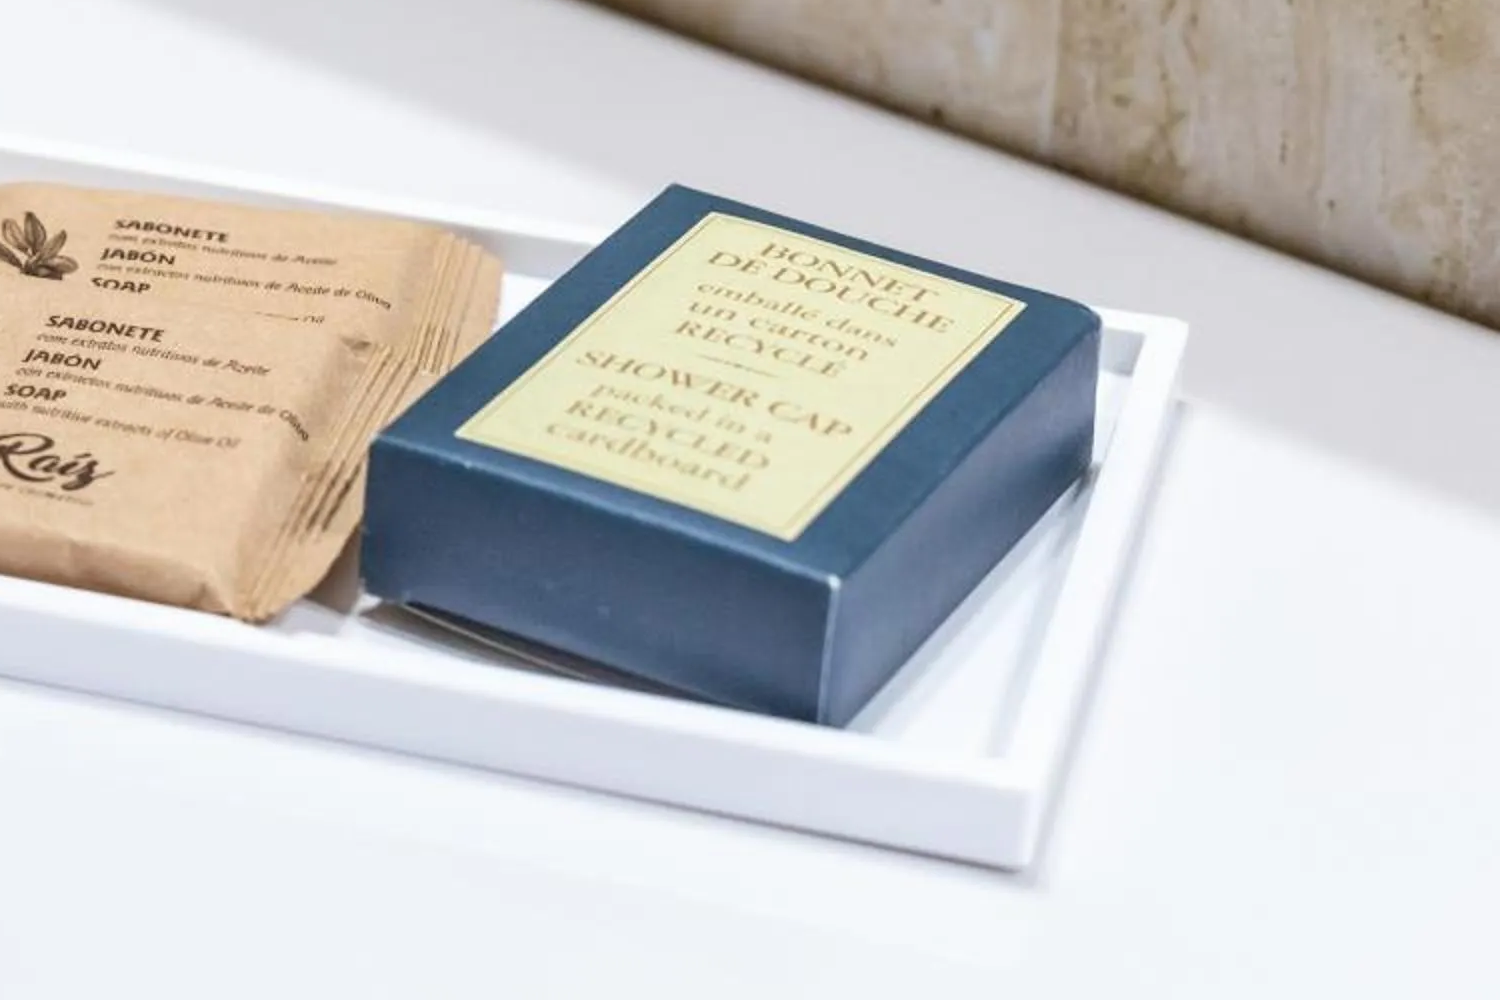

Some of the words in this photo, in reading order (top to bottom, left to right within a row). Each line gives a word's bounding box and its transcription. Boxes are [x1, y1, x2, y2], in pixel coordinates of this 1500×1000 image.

[100, 247, 176, 266] JABÓN
[114, 219, 229, 243] SABONETE
[708, 251, 767, 275] DE
[772, 266, 956, 333] DOUCHE
[760, 243, 940, 303] BONNET
[45, 315, 164, 342] SABONETE
[689, 301, 738, 322] un
[749, 315, 870, 361] carton
[697, 282, 820, 320] emballé
[825, 314, 898, 347] dans
[21, 349, 103, 371] JABÓN
[71, 337, 127, 353] extratos
[202, 357, 222, 367] de
[675, 320, 849, 379] RECYCLÉ
[3, 382, 67, 401] SOAP
[575, 350, 760, 408] SHOWER
[767, 399, 854, 437] CAP
[588, 383, 711, 422] packed
[714, 415, 747, 435] in
[754, 428, 773, 445] a
[546, 422, 751, 493] cardboard
[565, 399, 771, 470] RECYCLED
